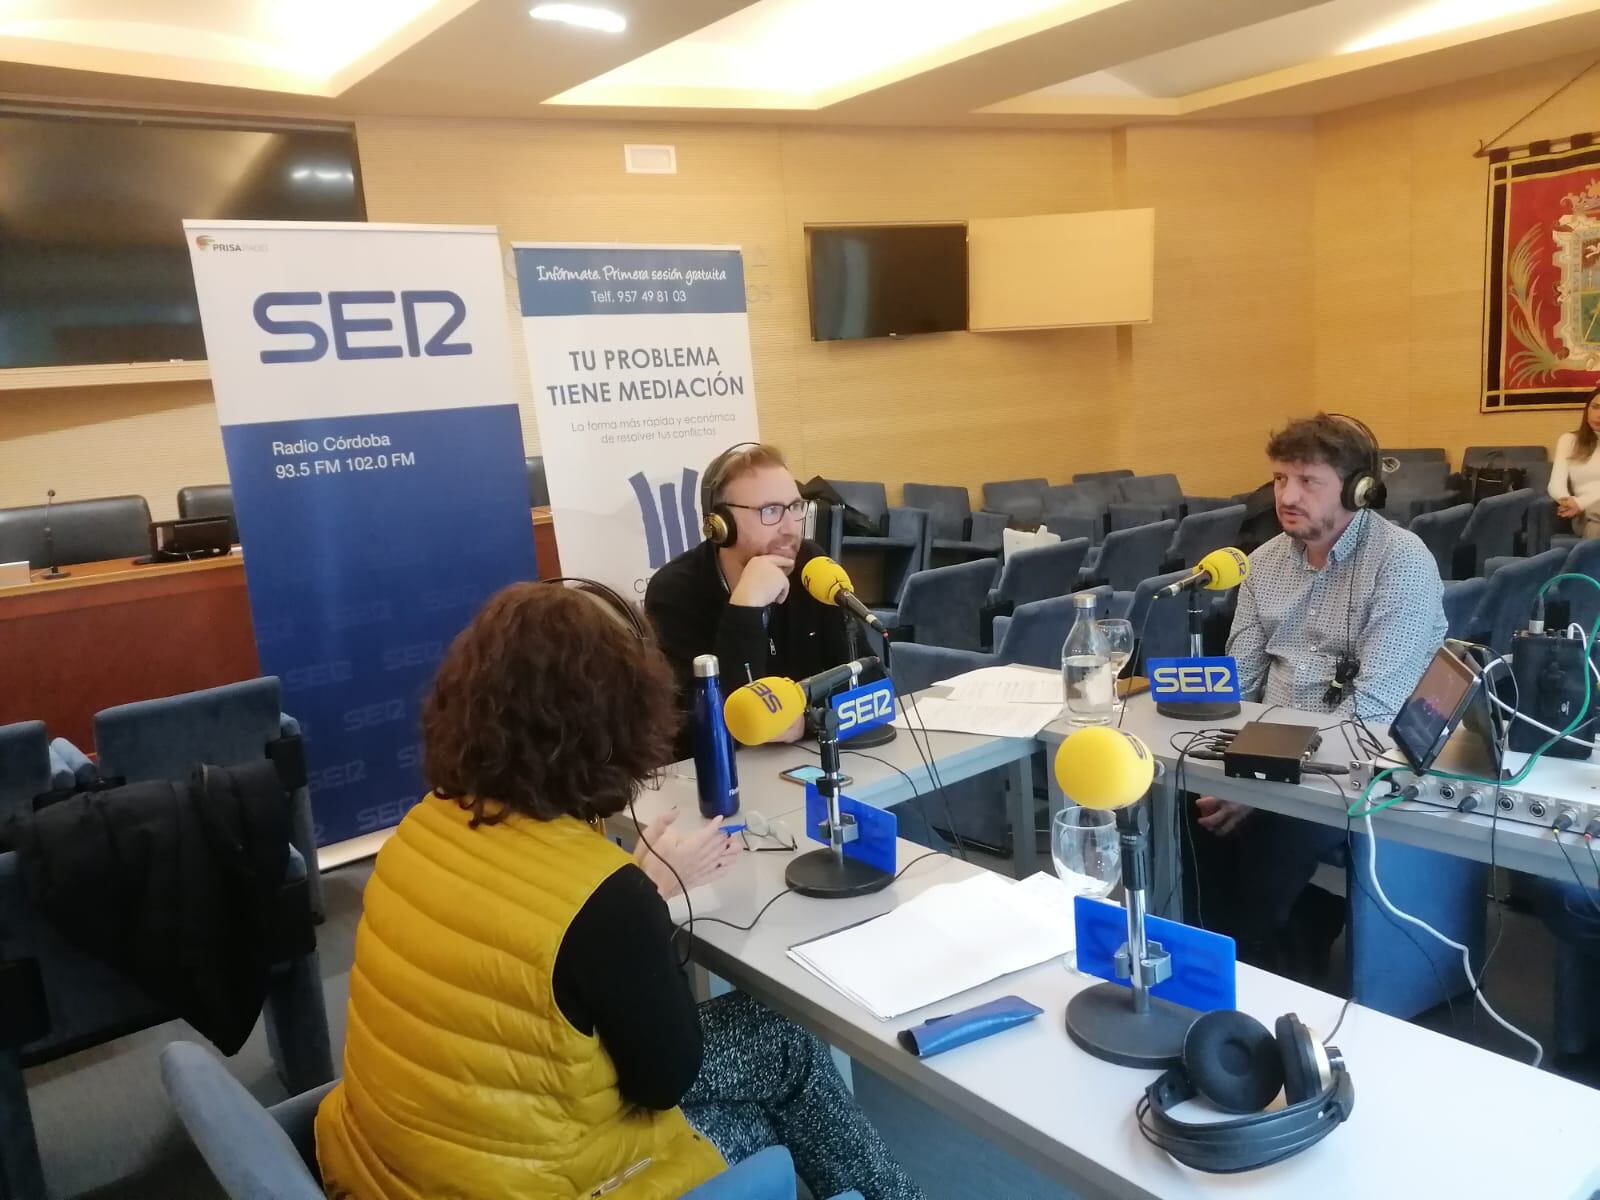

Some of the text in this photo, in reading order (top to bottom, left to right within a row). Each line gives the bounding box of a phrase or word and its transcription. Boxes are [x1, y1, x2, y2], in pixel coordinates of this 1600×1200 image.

[213, 243, 242, 252] PRISA
[602, 265, 649, 281] Primera
[651, 267, 683, 281] sesión
[686, 269, 727, 285] gratuita
[591, 290, 687, 303] Telf. 957 49 81 03
[253, 290, 473, 364] SER
[568, 347, 720, 371] TU PROBLEMA
[546, 371, 744, 406] TIENE MEDIACIÓN
[571, 423, 584, 432] La
[587, 419, 617, 431] forma
[619, 417, 641, 429] más
[643, 415, 675, 428] rápida
[684, 413, 736, 424] económica
[272, 434, 391, 456] Radio Córdoba
[601, 434, 614, 444] de
[616, 431, 655, 442] resolver
[657, 431, 671, 439] tus
[276, 452, 415, 479] 93.5 FM 102.0 FM
[1154, 667, 1233, 693] SER
[744, 681, 783, 713] SE
[837, 689, 892, 731] SER
